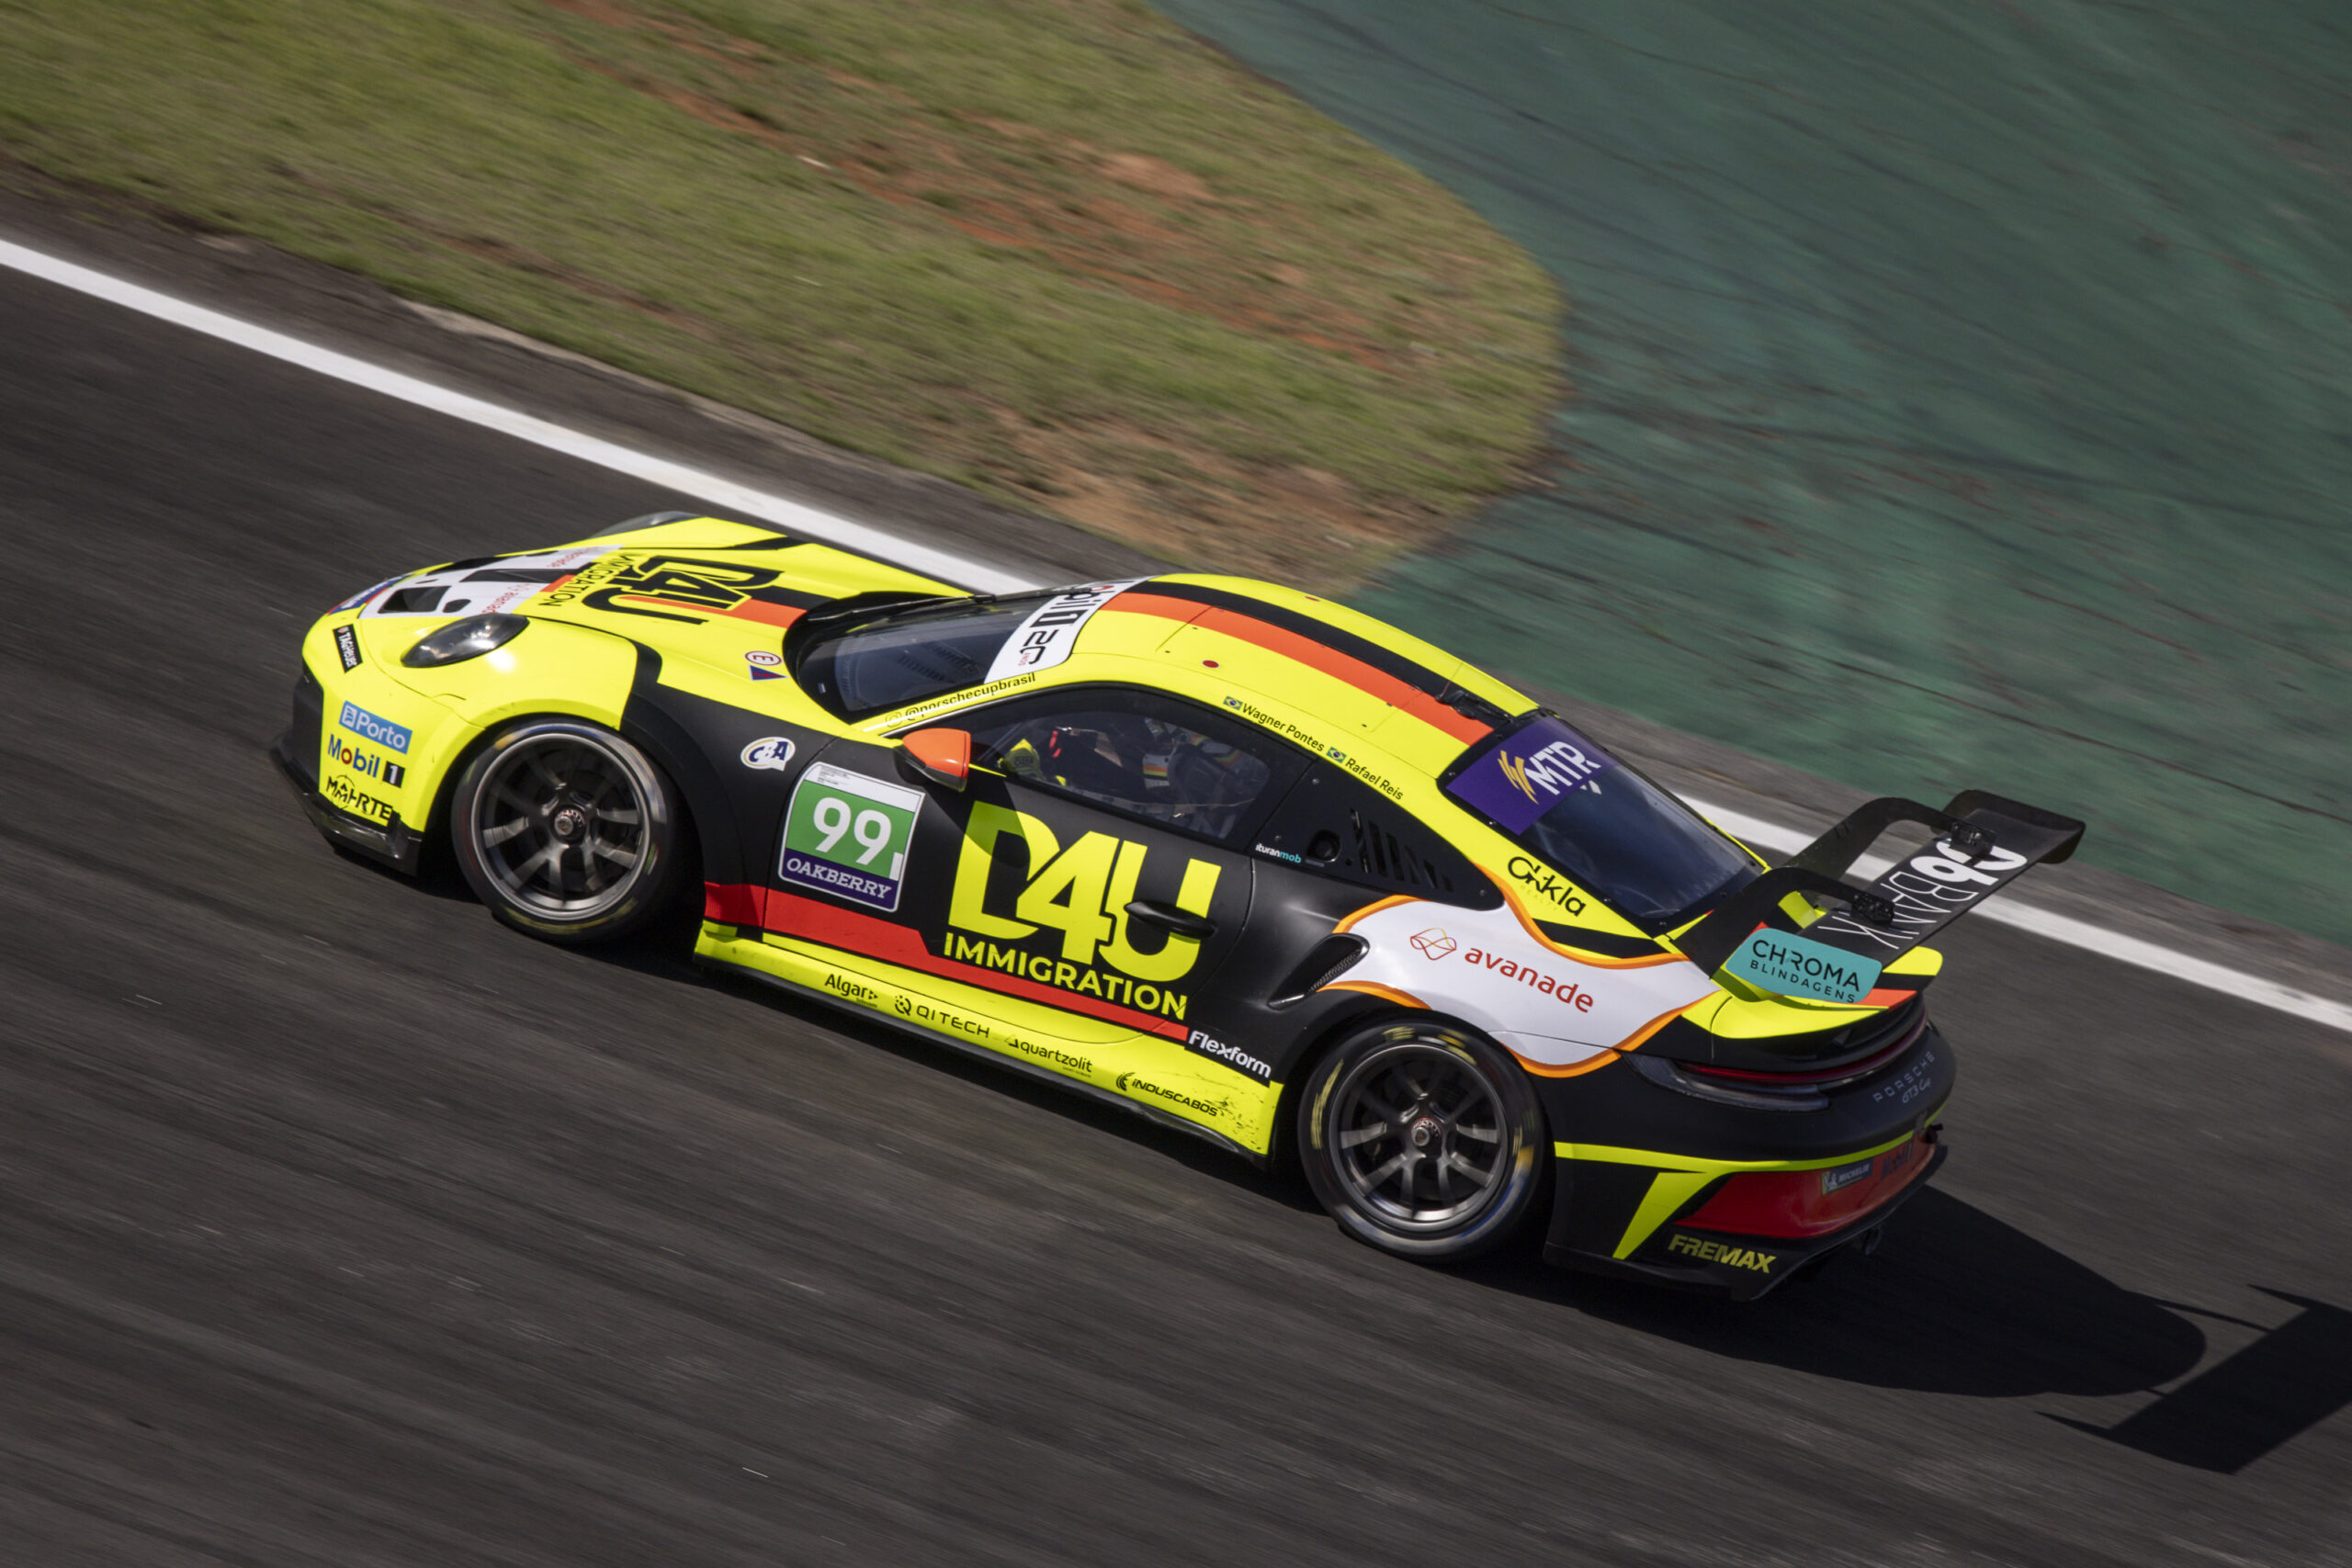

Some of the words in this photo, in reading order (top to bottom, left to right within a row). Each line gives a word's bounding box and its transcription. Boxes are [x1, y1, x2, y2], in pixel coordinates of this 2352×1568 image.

[582, 555, 786, 625] D4U
[906, 671, 1036, 722] @porschecupbrasil
[355, 712, 407, 749] Porto
[1242, 703, 1285, 730] Wagner
[1286, 724, 1325, 752] Pontes
[328, 734, 380, 778] Mobil
[1345, 758, 1378, 785] Rafael
[1379, 779, 1404, 801] Reis
[1524, 740, 1601, 796] MTR
[813, 796, 892, 865] 99
[786, 858, 892, 899] OAKBERRY
[948, 800, 1222, 982] D4U
[824, 974, 868, 998] Algar
[944, 931, 1188, 1020] IMMIGRATION
[1464, 947, 1594, 1013] avanade
[1749, 959, 1856, 1004] BLINDAGENS
[1752, 939, 1860, 992] CHROMA
[916, 1005, 935, 1021] QI
[939, 1011, 990, 1038] TECH
[1019, 1041, 1093, 1073] quartzolit
[1188, 1030, 1272, 1078] Flexform
[1872, 1051, 1935, 1102] PORSCHE
[1668, 1234, 1777, 1273] FREMAX
